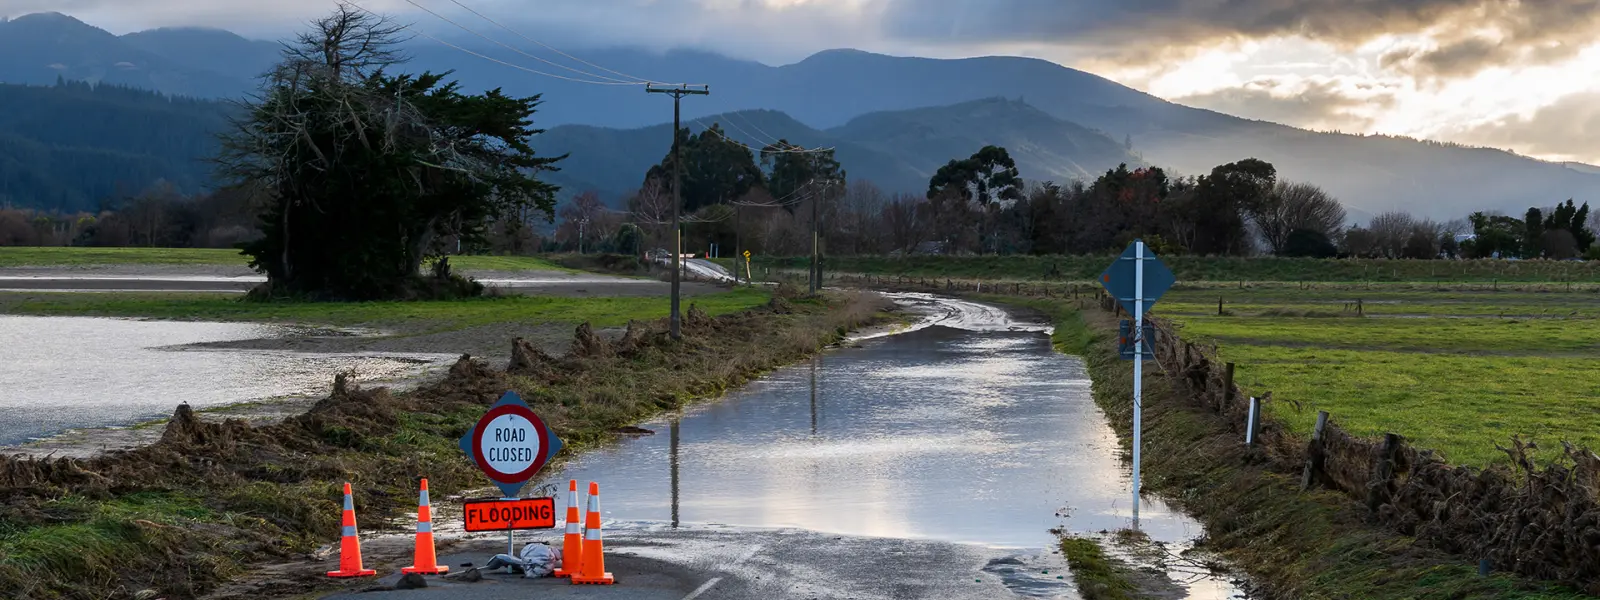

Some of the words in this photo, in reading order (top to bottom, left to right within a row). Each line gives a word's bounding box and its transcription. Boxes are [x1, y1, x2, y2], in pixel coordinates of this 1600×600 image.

[495, 428, 526, 442] ROAD
[489, 447, 532, 462] CLOSED
[468, 505, 550, 524] FLOODING
